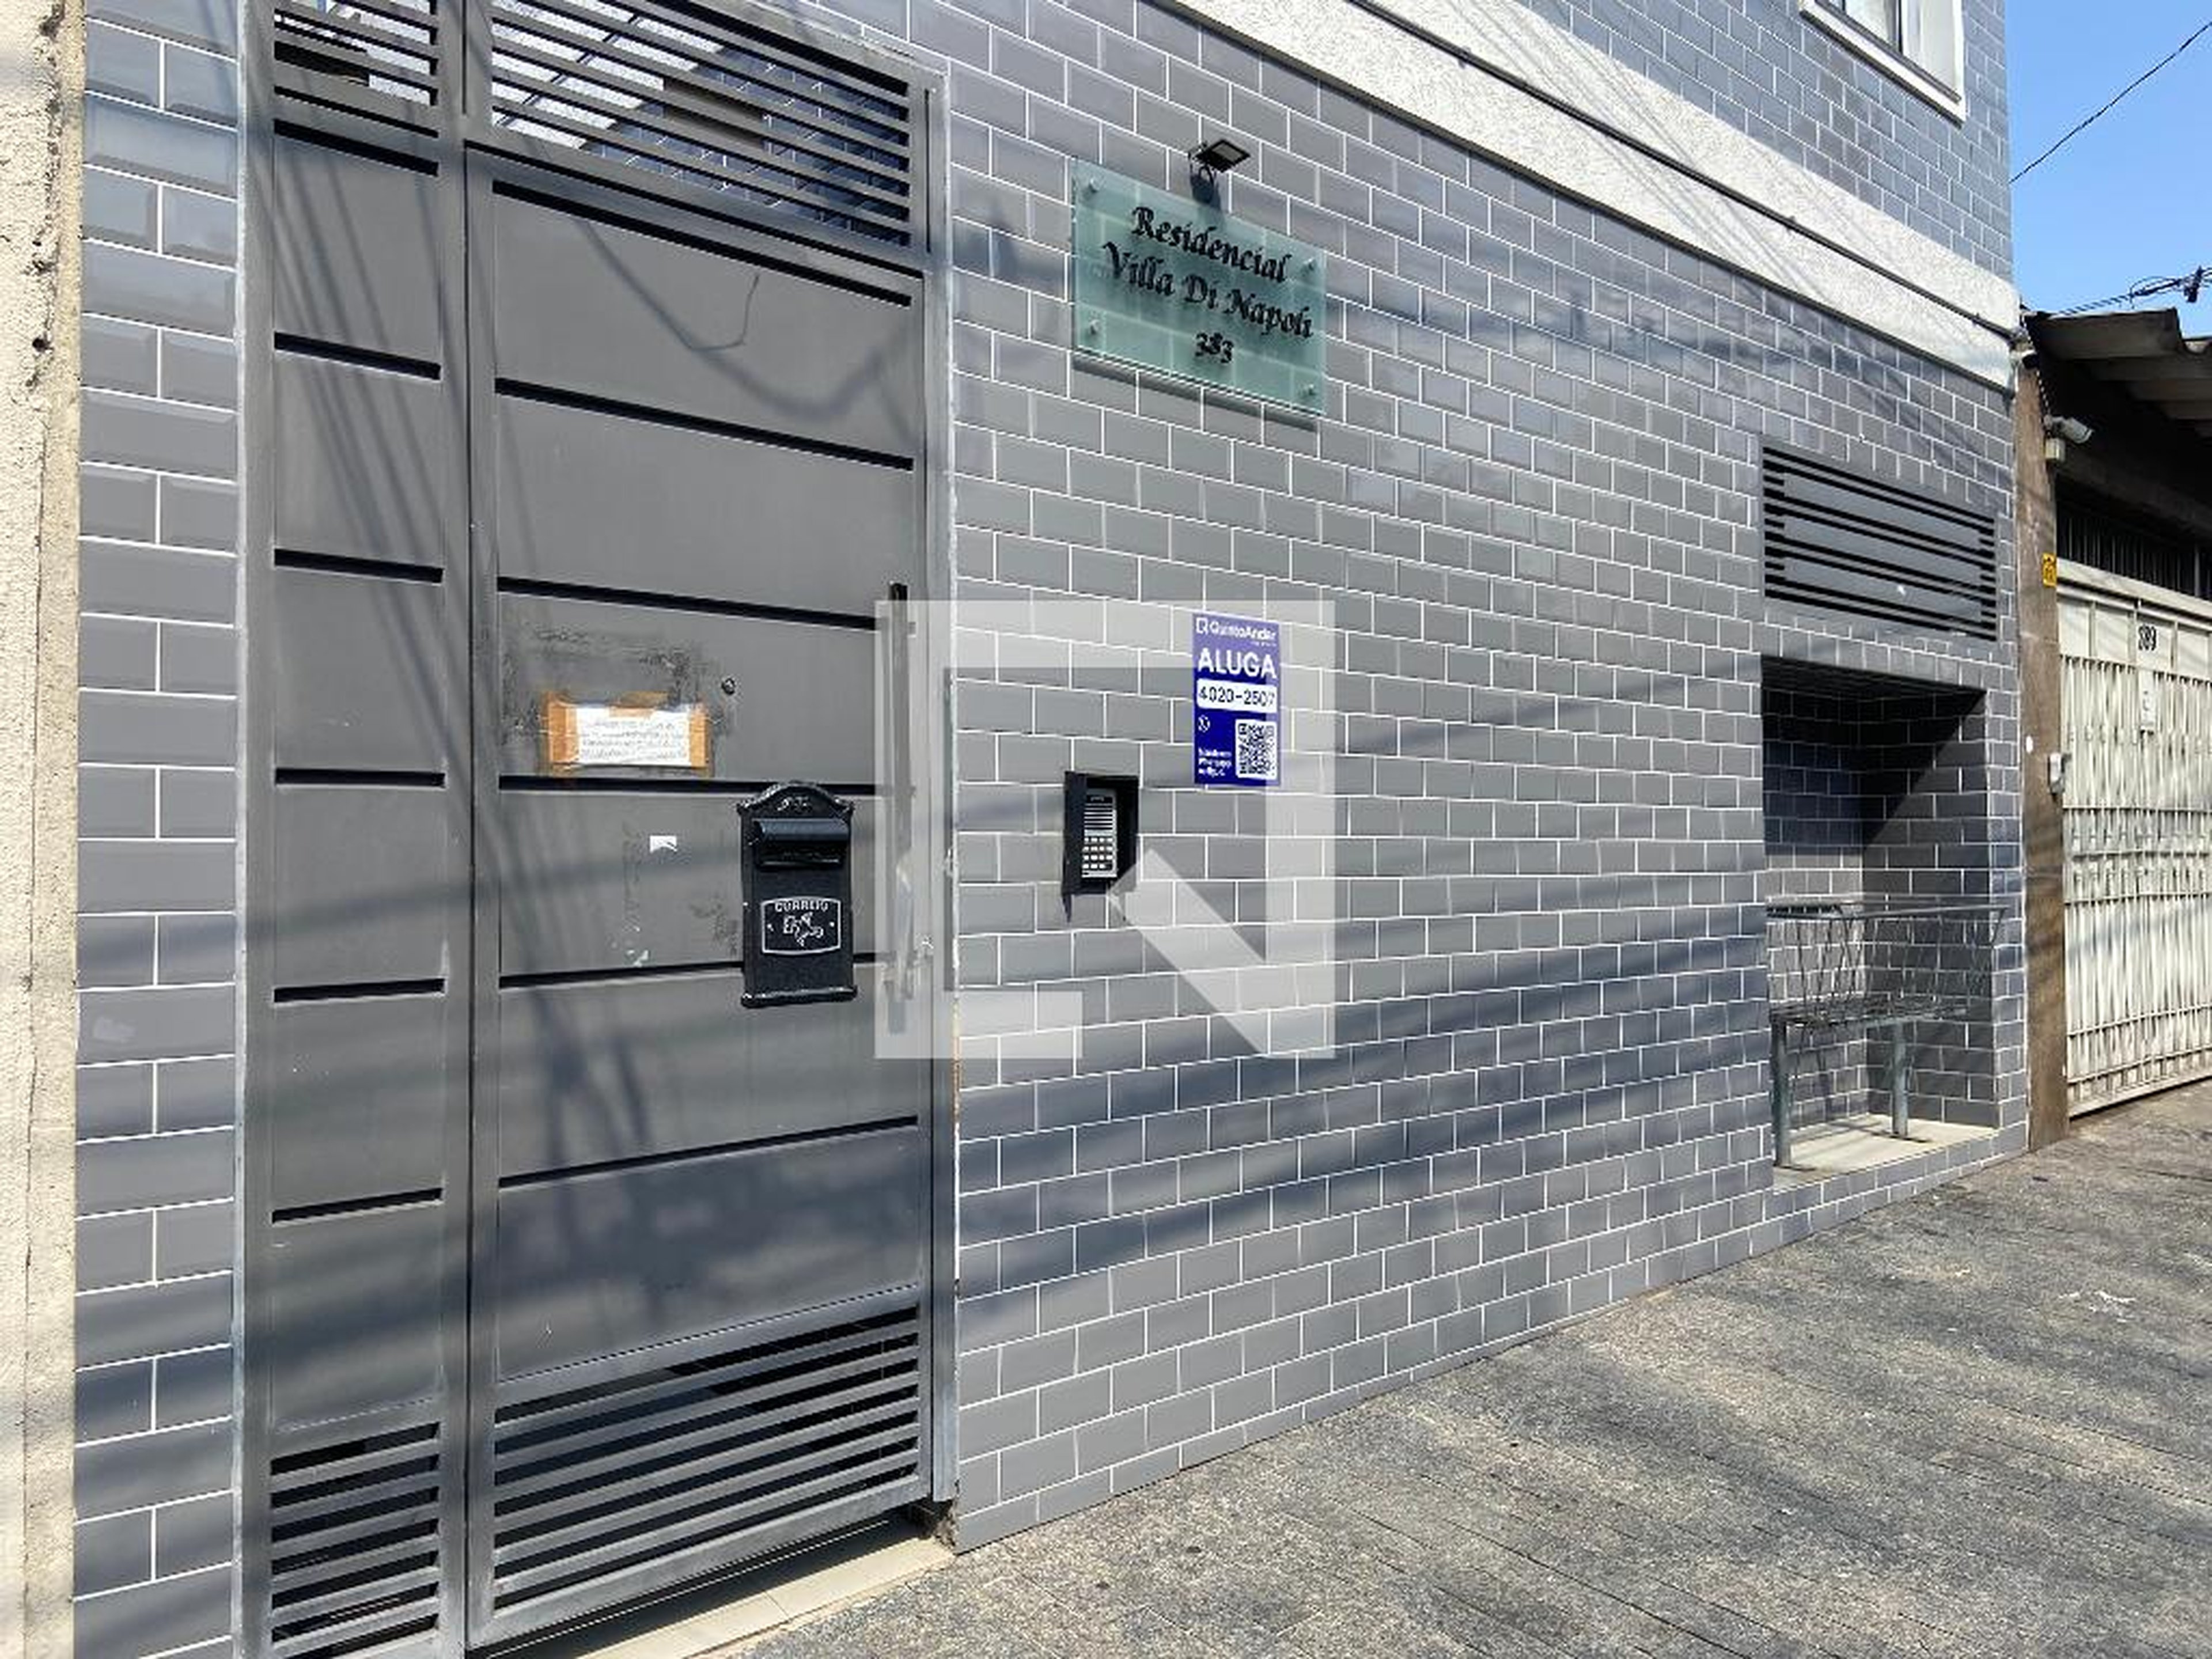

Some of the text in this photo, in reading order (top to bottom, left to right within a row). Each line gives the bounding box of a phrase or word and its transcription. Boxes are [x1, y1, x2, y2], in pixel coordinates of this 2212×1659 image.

[1132, 206, 1292, 283] Residencial
[1103, 241, 1314, 338] Villa Di Napoli
[1198, 647, 1277, 679] ALUGA
[1198, 685, 1275, 707] 4020-2507
